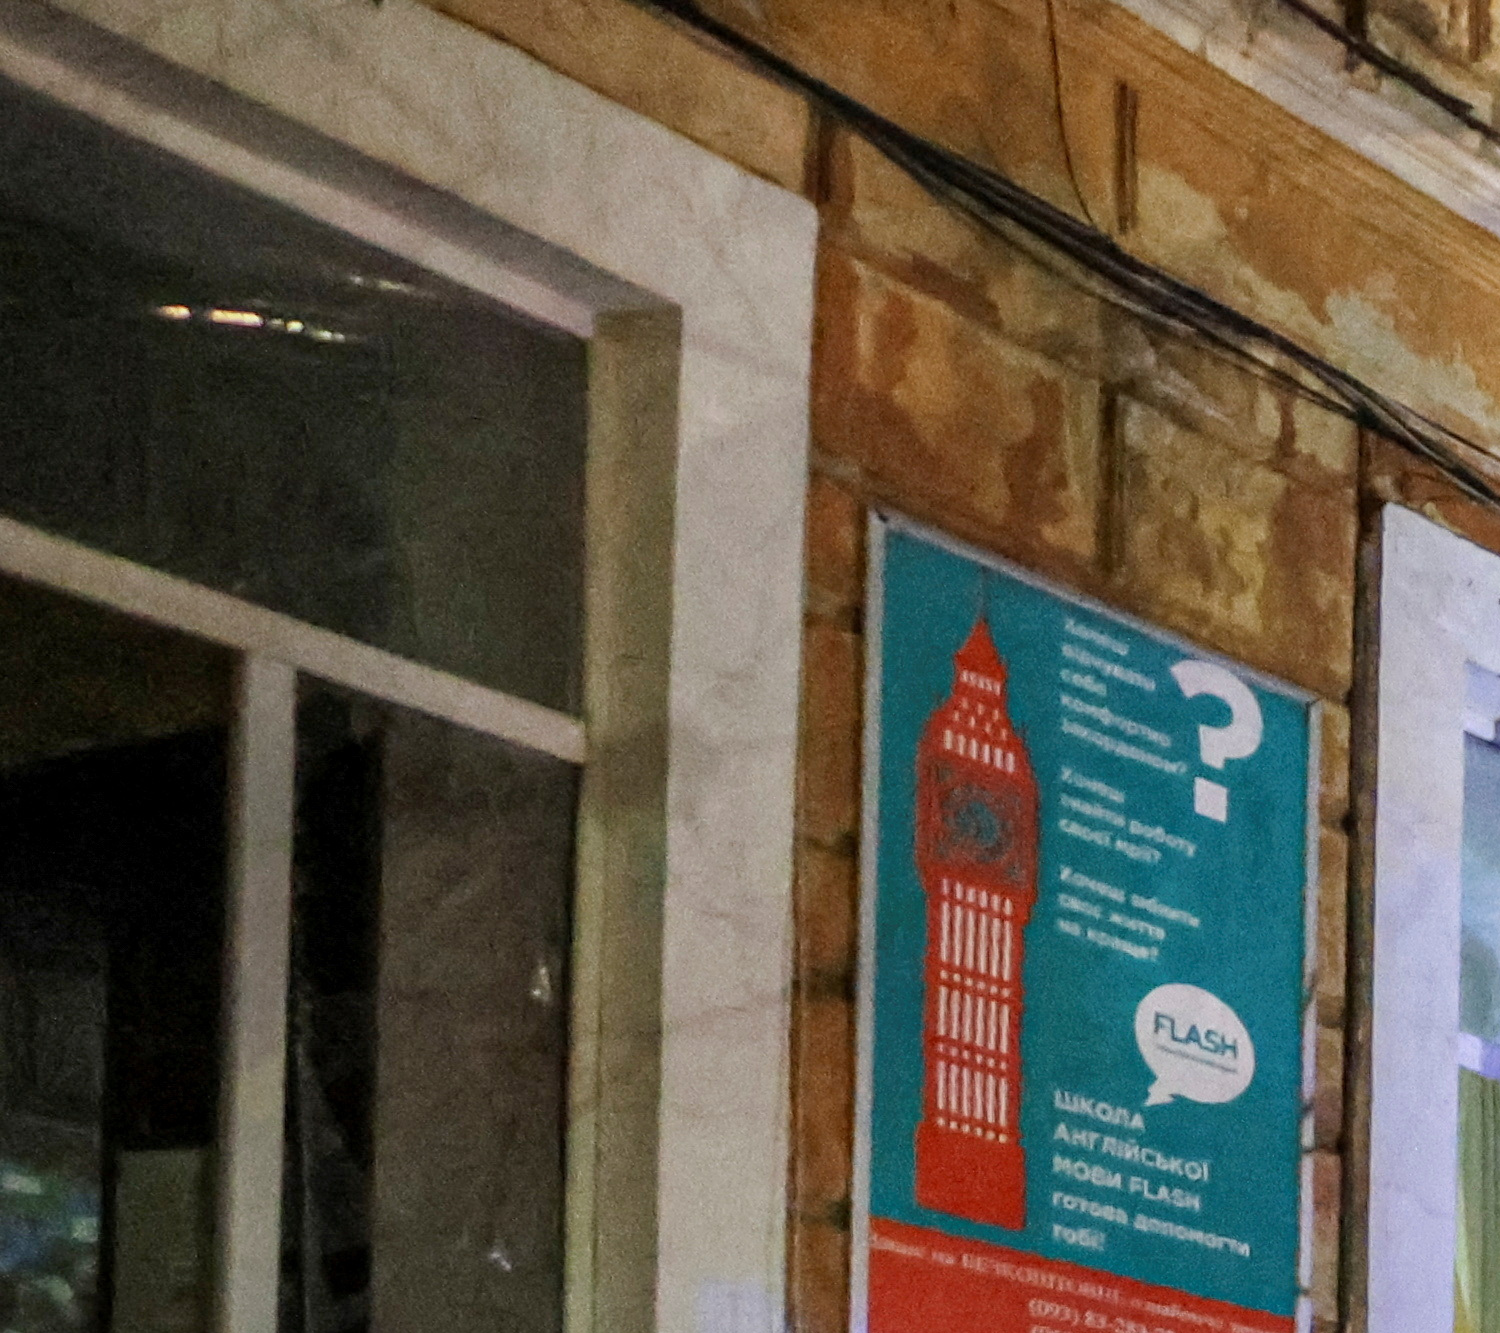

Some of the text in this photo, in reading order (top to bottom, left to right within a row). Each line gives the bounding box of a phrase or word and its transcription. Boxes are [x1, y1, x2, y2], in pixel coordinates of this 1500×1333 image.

[1153, 1011, 1238, 1060] FLASH
[1054, 1089, 1146, 1131] ШКОЛА
[1053, 1122, 1210, 1183] АНГЛІЙСЬКОЇ
[1052, 1155, 1200, 1213] МОВИ FLASH
